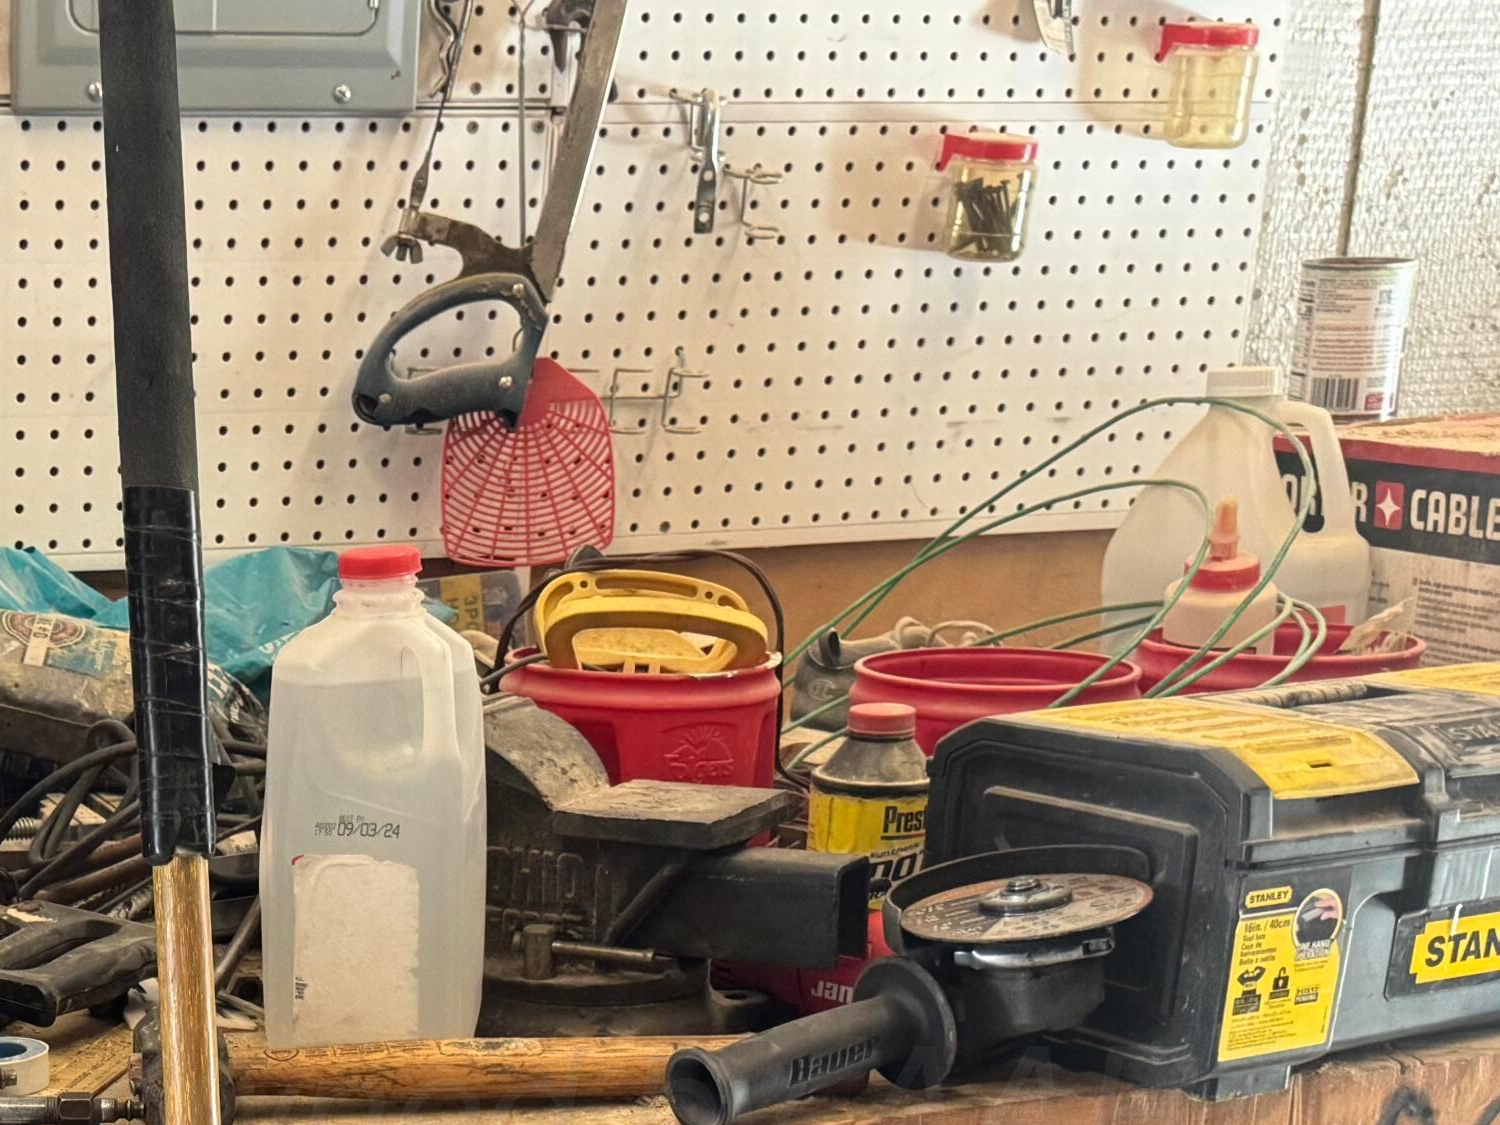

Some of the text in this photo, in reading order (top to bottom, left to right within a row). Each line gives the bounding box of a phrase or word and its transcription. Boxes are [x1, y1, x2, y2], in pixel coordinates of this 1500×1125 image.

[1409, 487, 1500, 542] CABLE
[336, 821, 401, 840] 09/03/24
[1248, 889, 1290, 905] STANLEY
[1269, 918, 1291, 930] 40cm
[787, 1035, 882, 1088] Bauer
